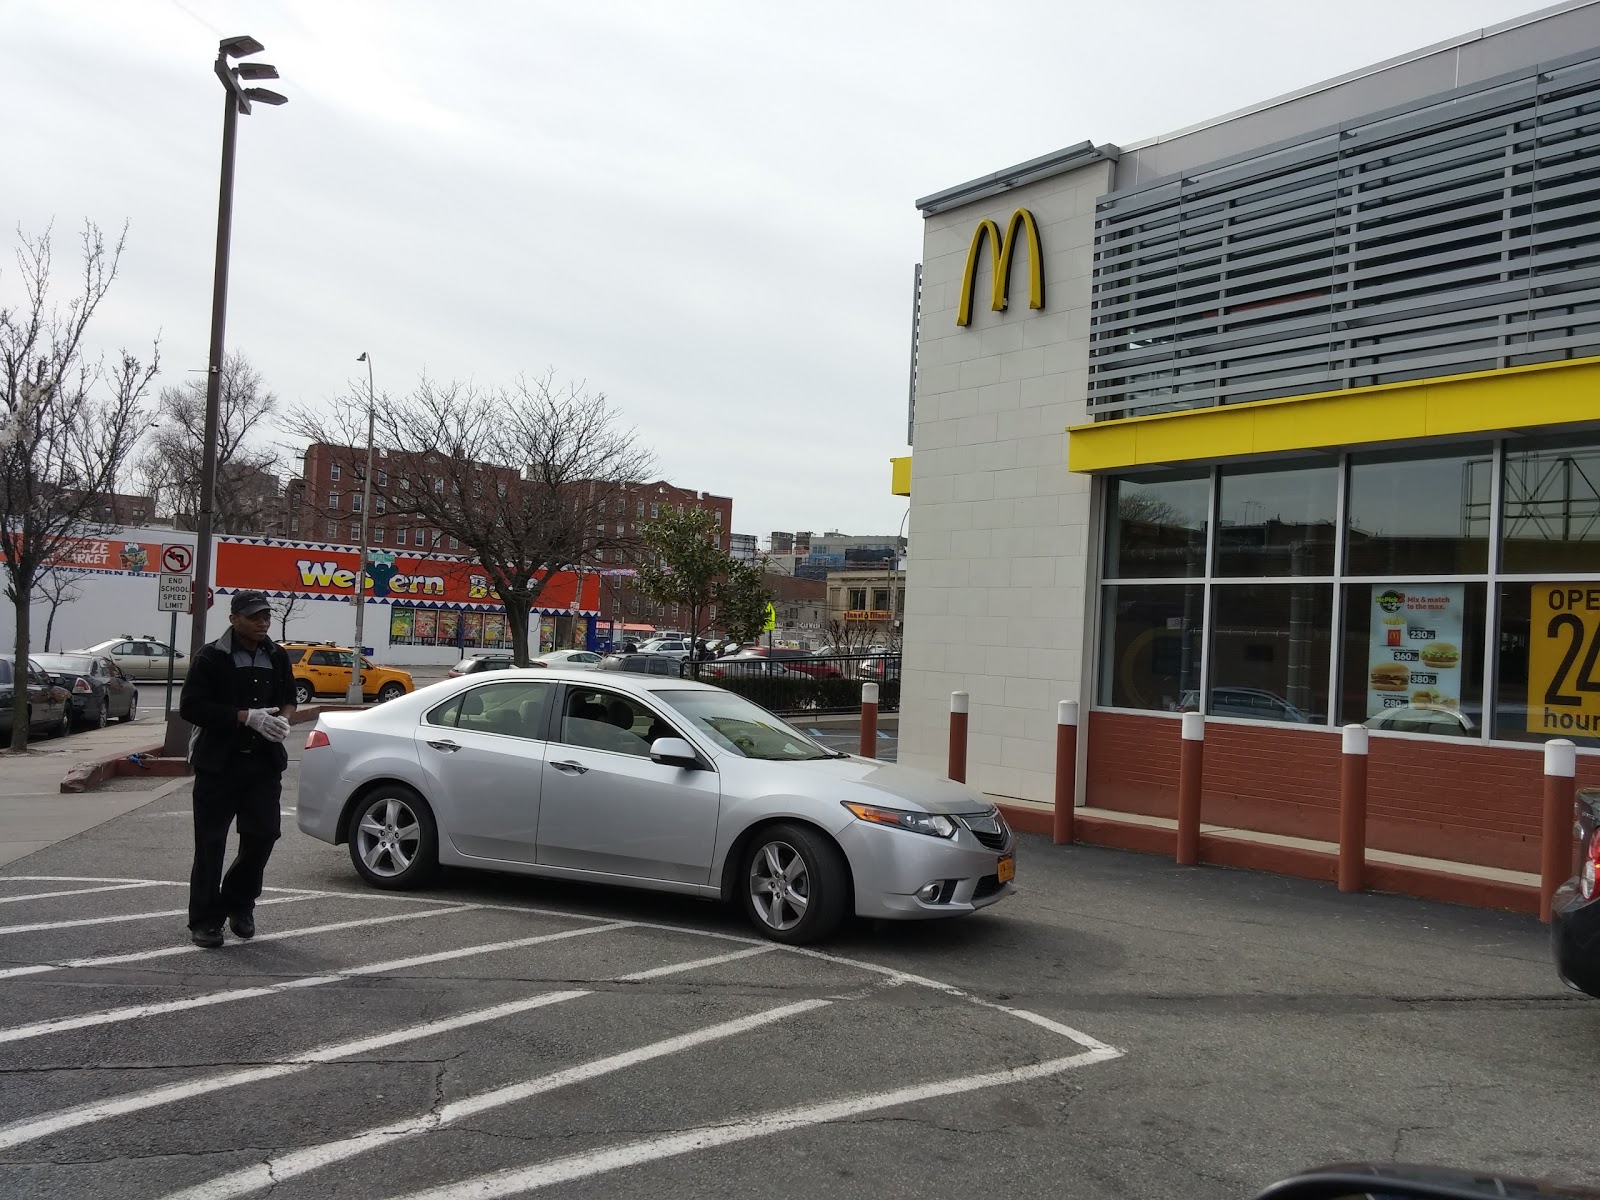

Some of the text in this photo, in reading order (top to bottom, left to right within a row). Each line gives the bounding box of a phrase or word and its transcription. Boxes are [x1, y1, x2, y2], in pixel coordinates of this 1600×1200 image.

[54, 566, 125, 576] WESTERN
[160, 585, 190, 593] SCHOOL
[163, 593, 187, 601] SPEED
[1410, 630, 1428, 639] 230
[1394, 652, 1412, 661] 360
[1411, 675, 1429, 684] 380
[1385, 699, 1402, 708] 280
